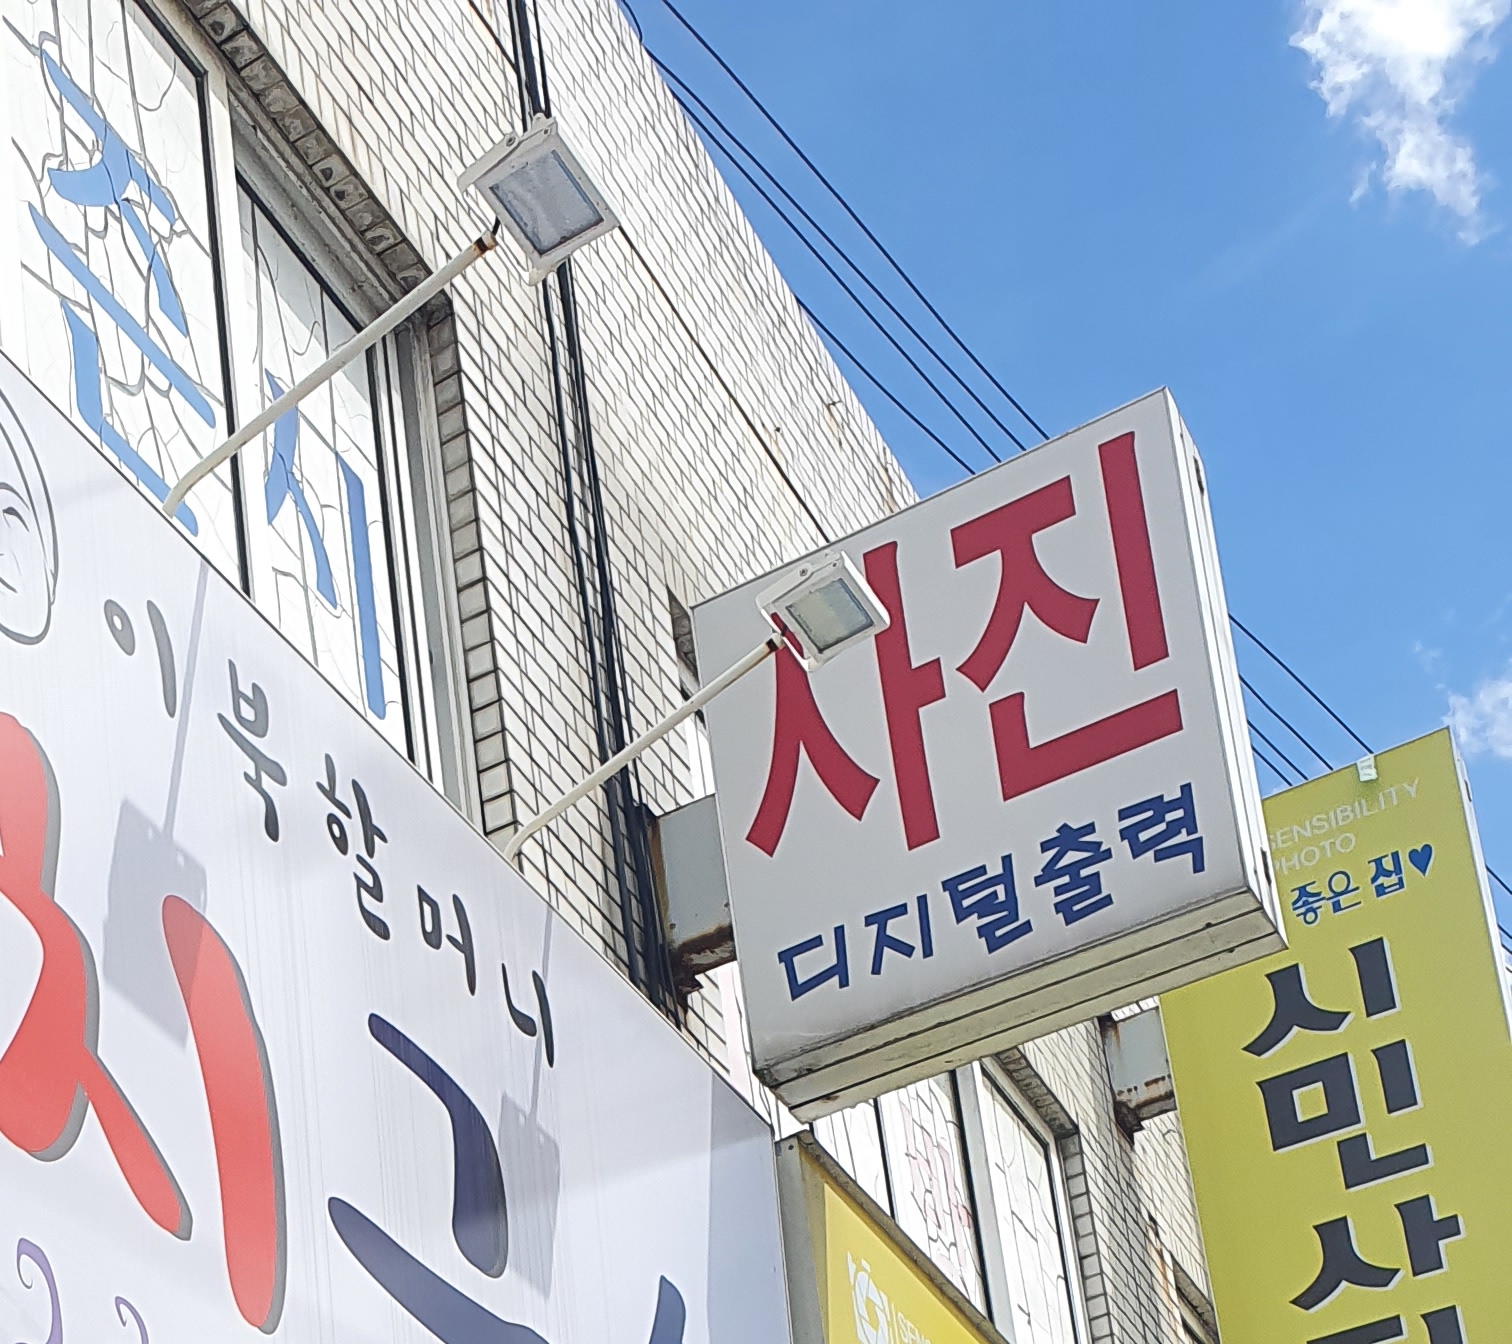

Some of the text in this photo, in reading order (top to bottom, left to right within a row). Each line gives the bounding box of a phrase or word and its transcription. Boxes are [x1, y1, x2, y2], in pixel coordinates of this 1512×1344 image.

[745, 431, 1184, 857] 사진
[103, 598, 556, 1067] 이북할머니
[777, 781, 1205, 1001] 디지털출력
[1267, 778, 1420, 851] SENSIBILITY
[1291, 850, 1405, 926] 좋은 집
